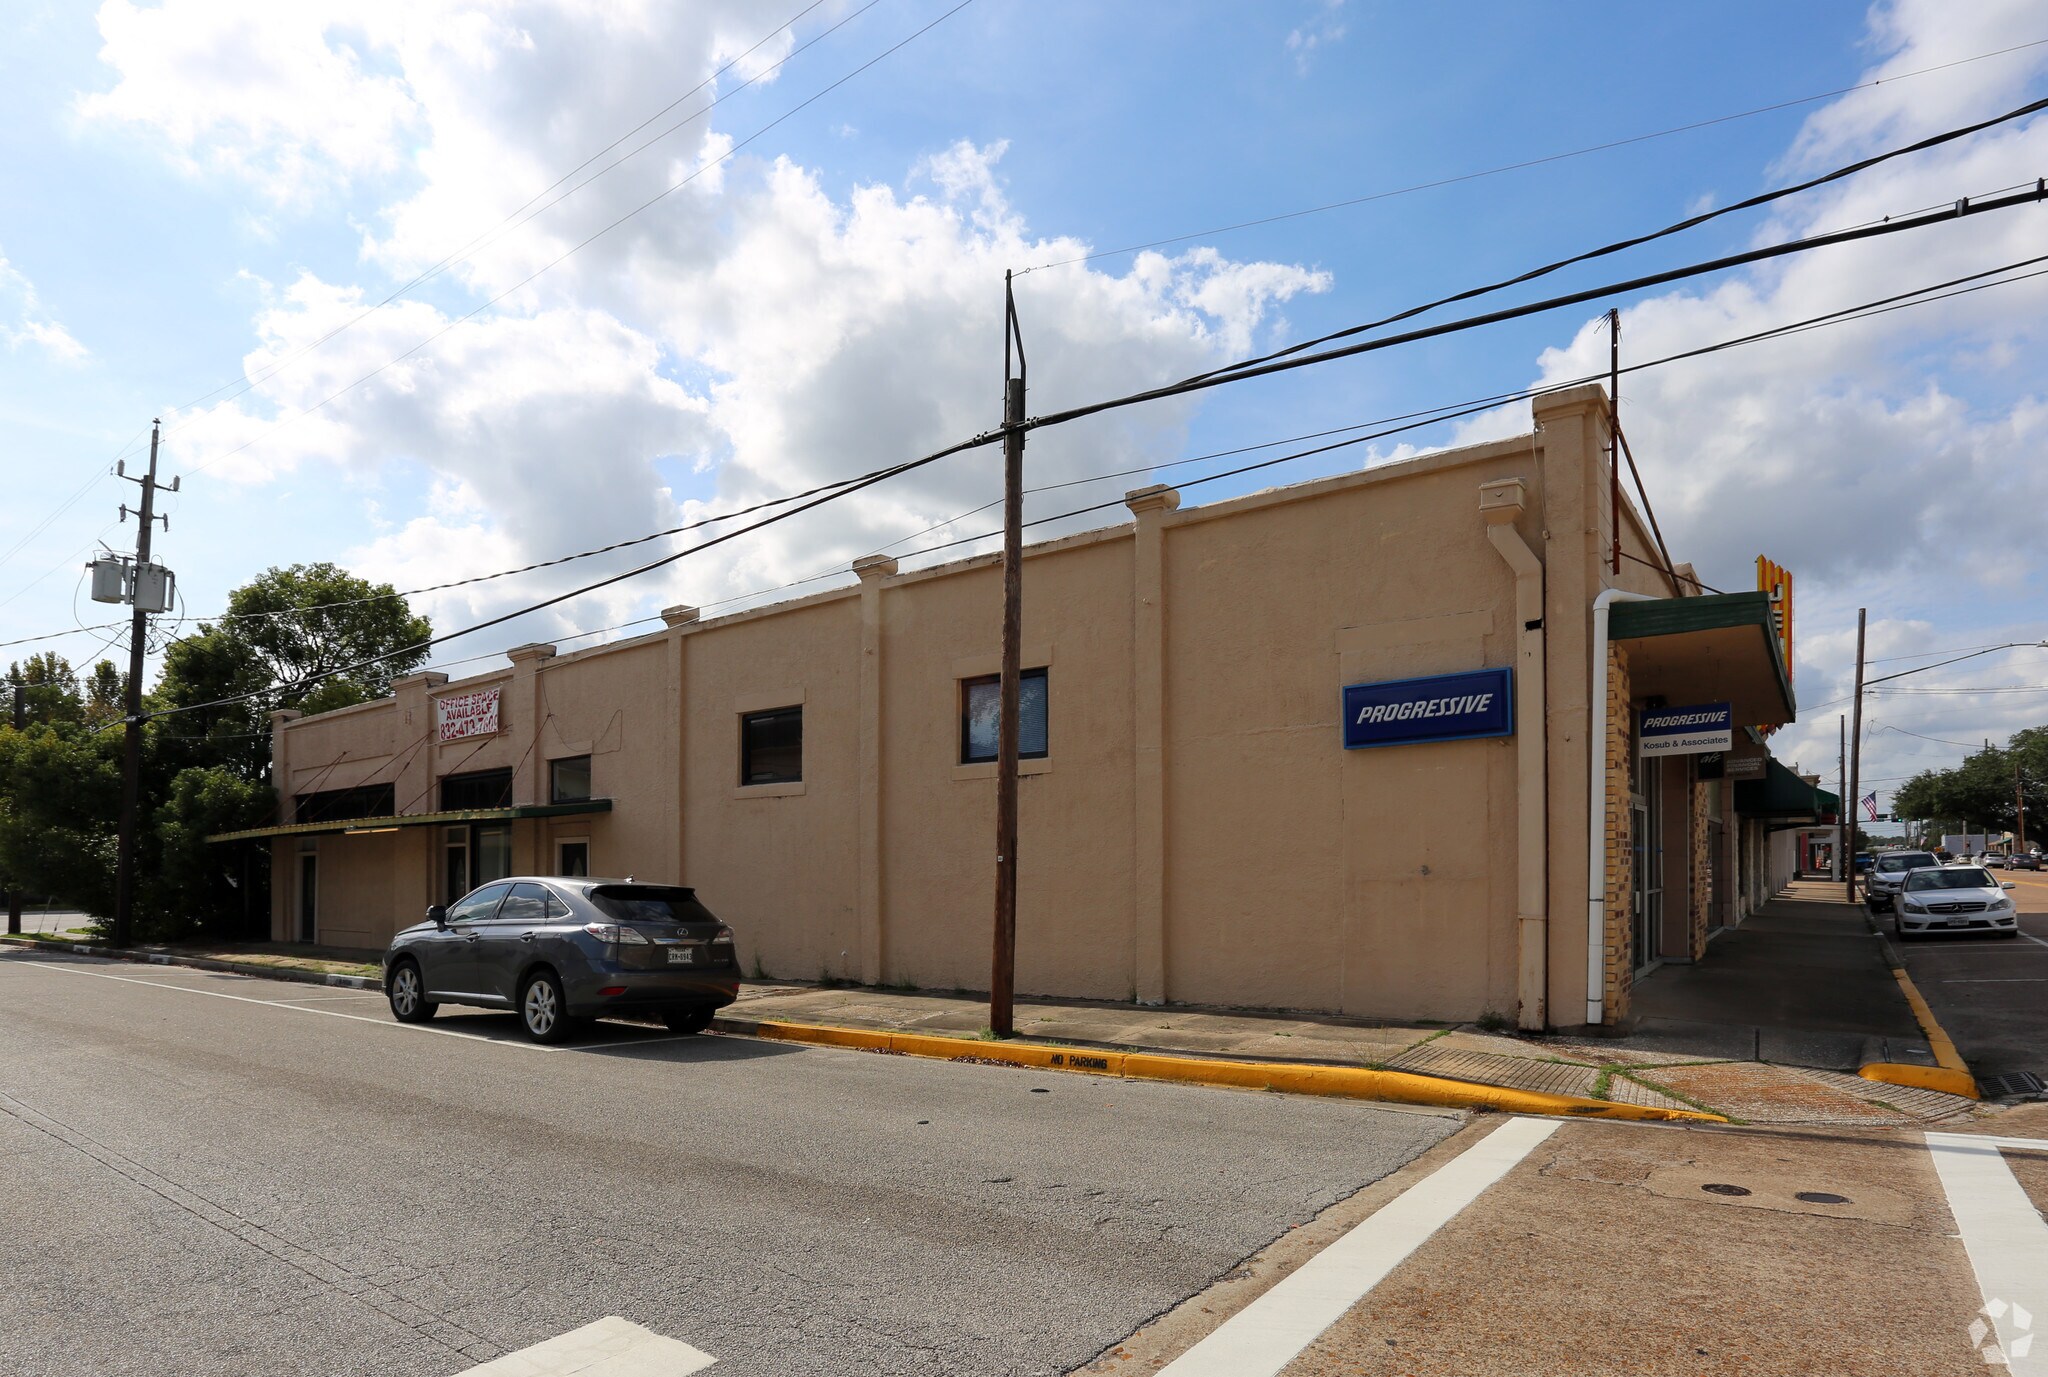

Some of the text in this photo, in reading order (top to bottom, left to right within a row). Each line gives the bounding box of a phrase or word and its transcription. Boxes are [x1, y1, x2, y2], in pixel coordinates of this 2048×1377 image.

[440, 690, 499, 710] OFFICE SPACE
[1356, 693, 1493, 725] PROGRESSIVE
[446, 702, 493, 720] AVAILABLE
[1643, 711, 1728, 729] PROGRESSIVE
[1643, 736, 1729, 750] Kosub & Associates
[1051, 1054, 1107, 1070] NO PARKING
